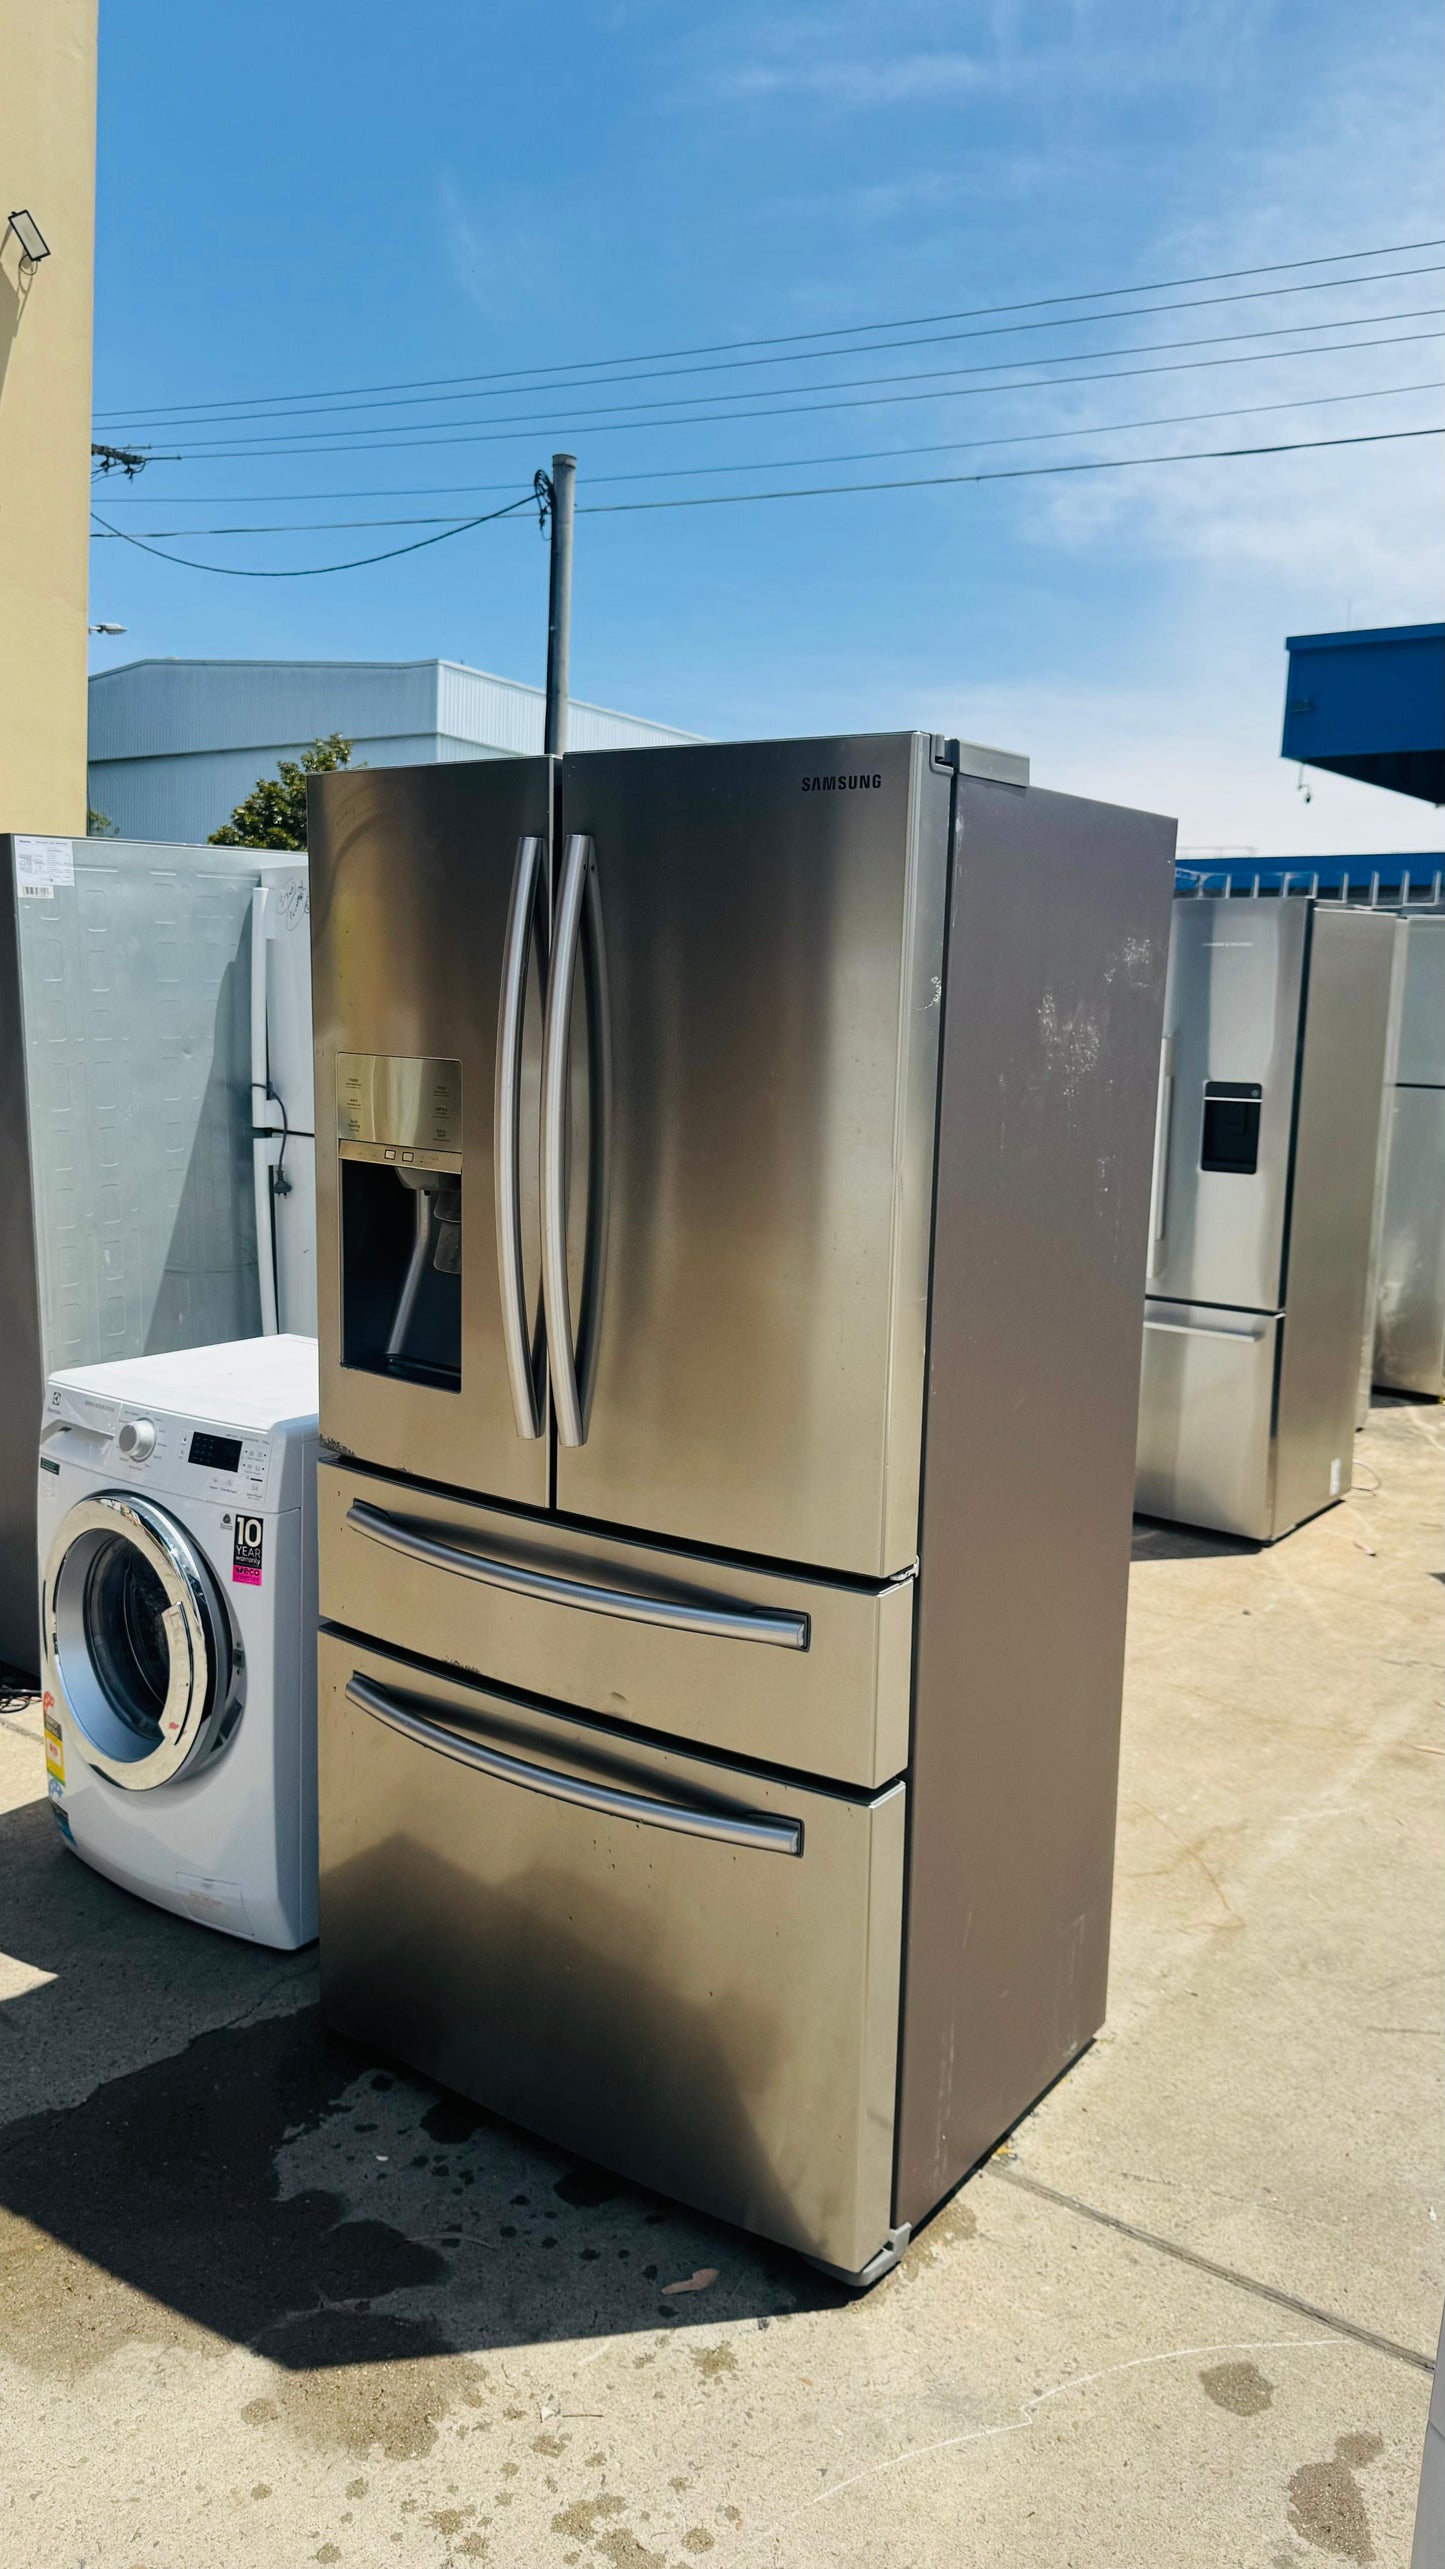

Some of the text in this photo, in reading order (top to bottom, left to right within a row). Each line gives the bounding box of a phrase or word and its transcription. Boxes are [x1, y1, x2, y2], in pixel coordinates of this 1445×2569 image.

[801, 774, 882, 792] SAMSUNG
[237, 1517, 262, 1548] 10
[235, 1545, 261, 1559] YEAR
[235, 1556, 260, 1566] warranty
[243, 1567, 260, 1577] eco
